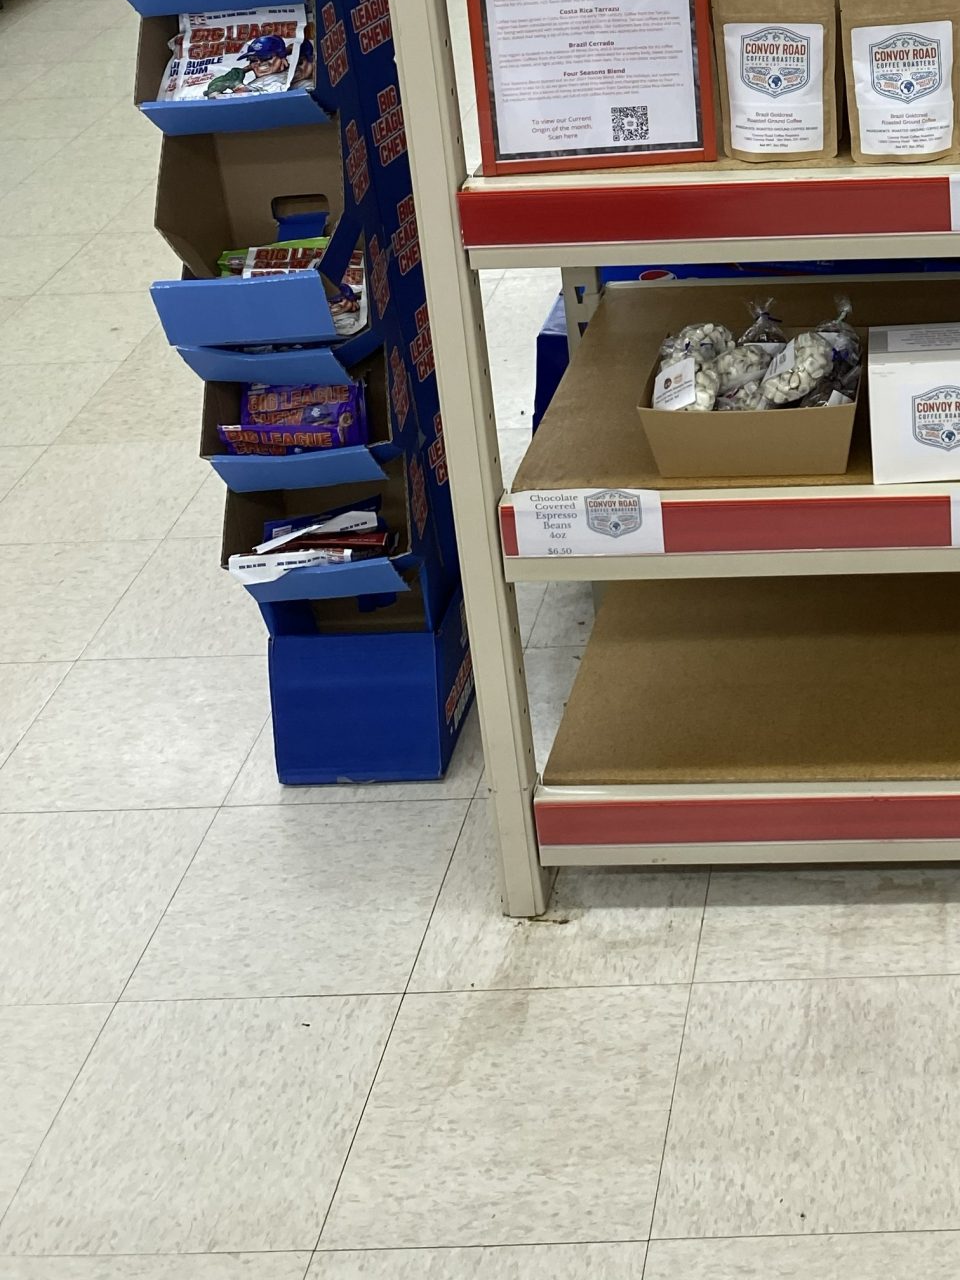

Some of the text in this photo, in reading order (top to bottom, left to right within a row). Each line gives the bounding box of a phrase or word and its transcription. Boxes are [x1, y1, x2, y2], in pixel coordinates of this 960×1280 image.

[559, 8, 578, 16] Costa
[359, 17, 392, 55] CHEW
[568, 40, 615, 48] Brazil Cerrado
[745, 42, 806, 56] CONVOY ROAD
[563, 68, 626, 78] Four Seasons Blend
[916, 401, 953, 414] CONVOY
[918, 412, 942, 420] COFFEE
[530, 494, 578, 502] Chocolate
[534, 502, 576, 510] Covered
[536, 512, 578, 520] Espresso
[543, 522, 572, 530] Beans
[550, 531, 566, 539] 4oz
